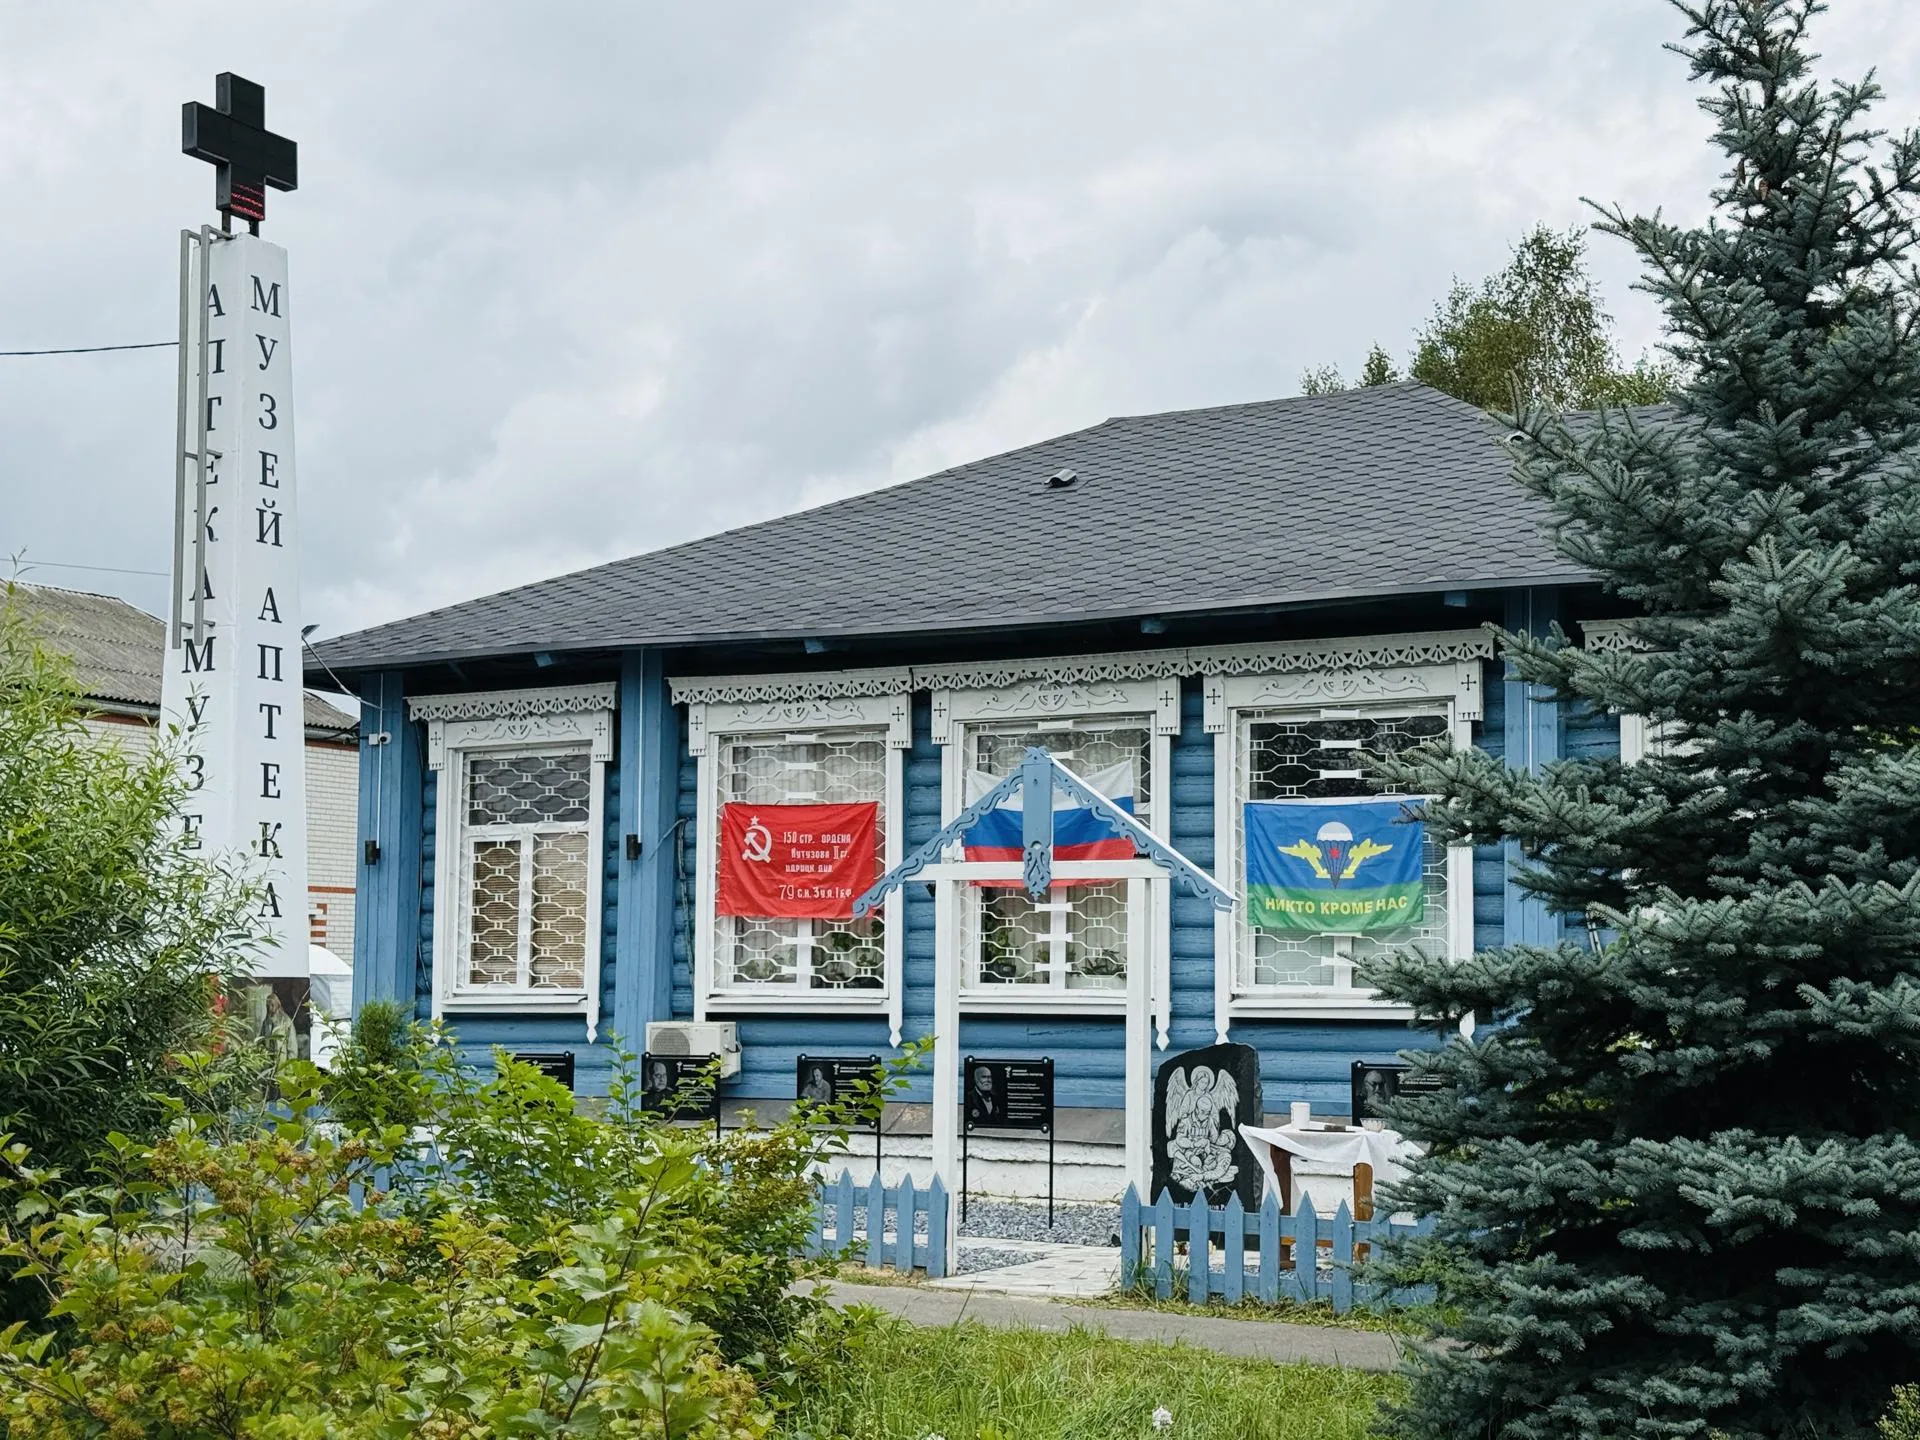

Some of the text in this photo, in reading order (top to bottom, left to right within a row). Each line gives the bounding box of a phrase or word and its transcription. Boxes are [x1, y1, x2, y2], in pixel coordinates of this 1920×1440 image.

[249, 274, 284, 919] МУЗЕЙ АПТЕКА
[174, 636, 217, 912] МУЗЕ
[783, 831, 798, 844] 150
[778, 884, 795, 900] 79
[1265, 895, 1408, 915] НИКТО КРОМЕ НАС
